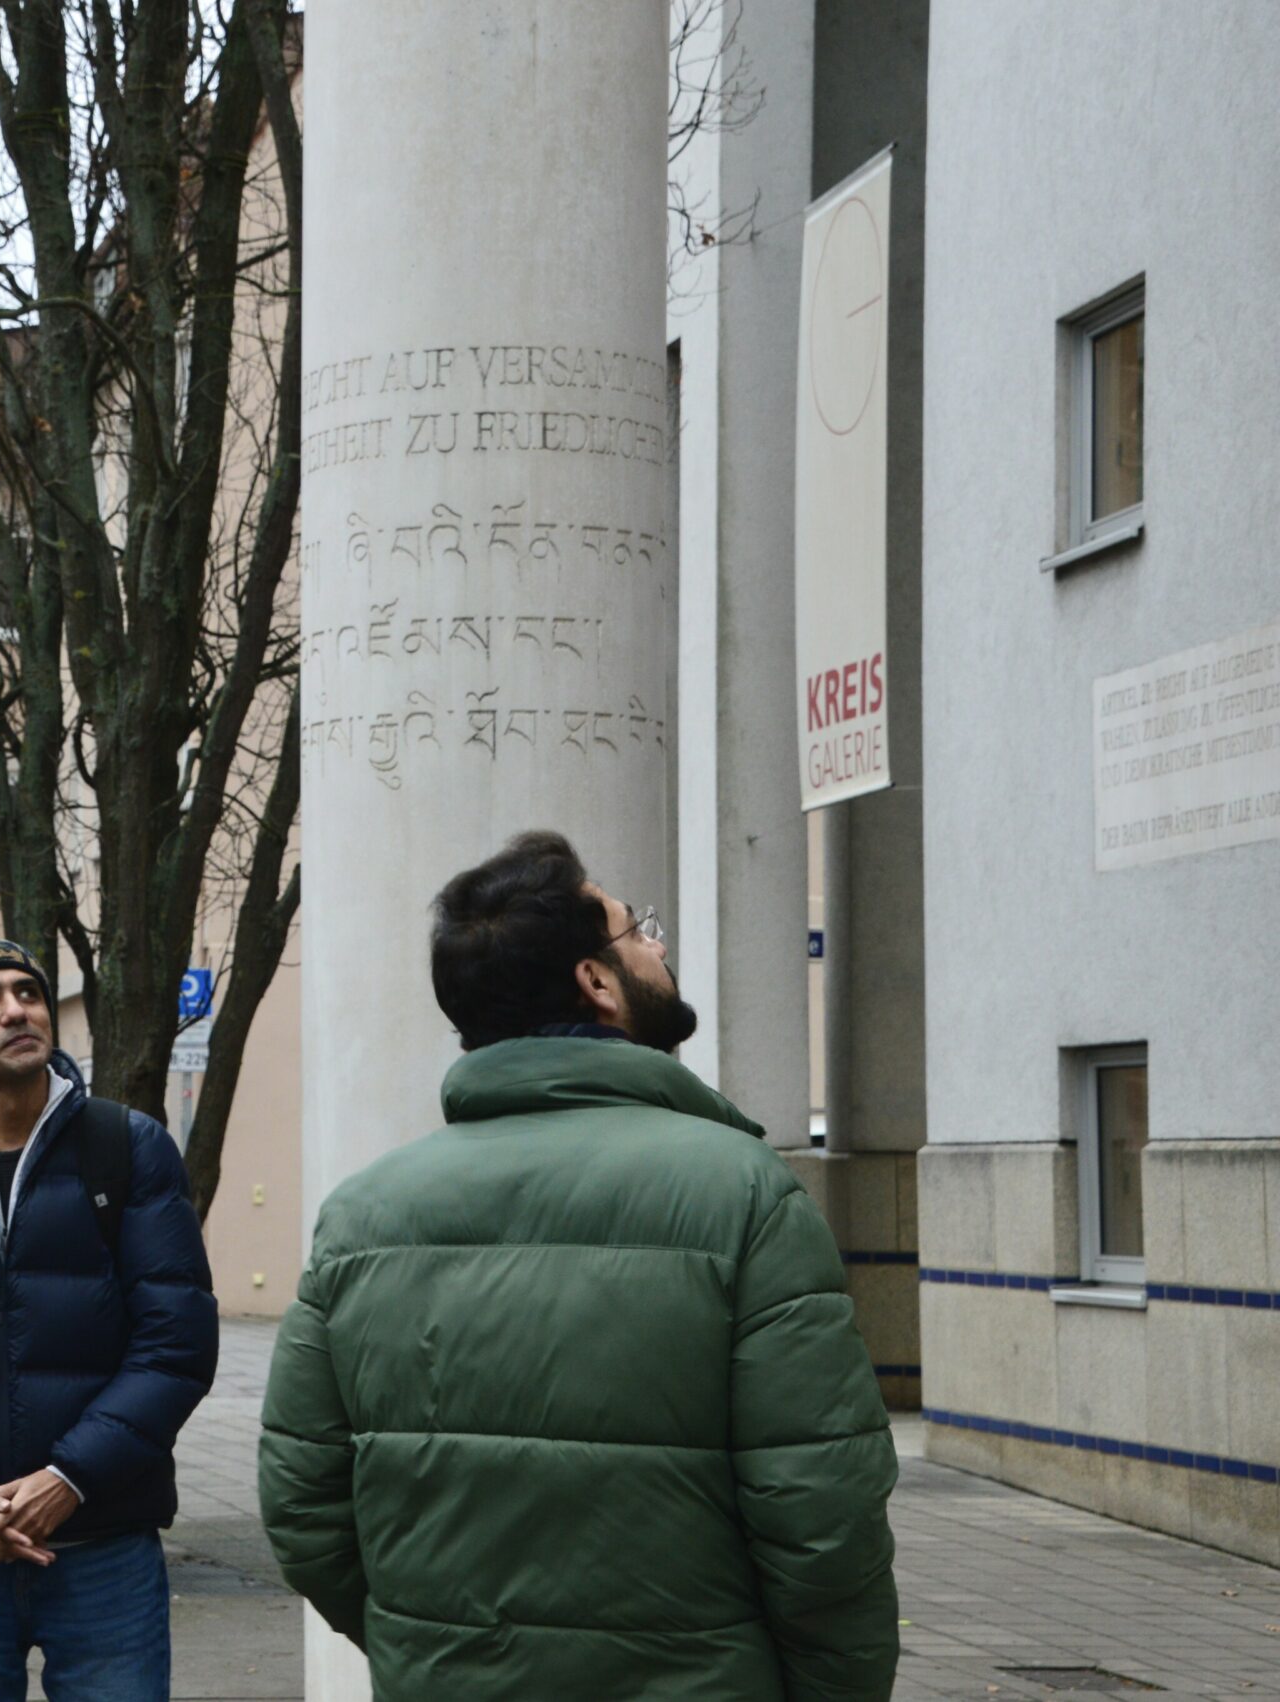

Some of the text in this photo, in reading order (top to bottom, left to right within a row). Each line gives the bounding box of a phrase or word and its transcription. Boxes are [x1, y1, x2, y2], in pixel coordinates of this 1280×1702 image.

[379, 347, 456, 393] AUF
[405, 412, 460, 457] ZU
[807, 653, 882, 733] KREIS
[808, 726, 882, 789] GALERIE
